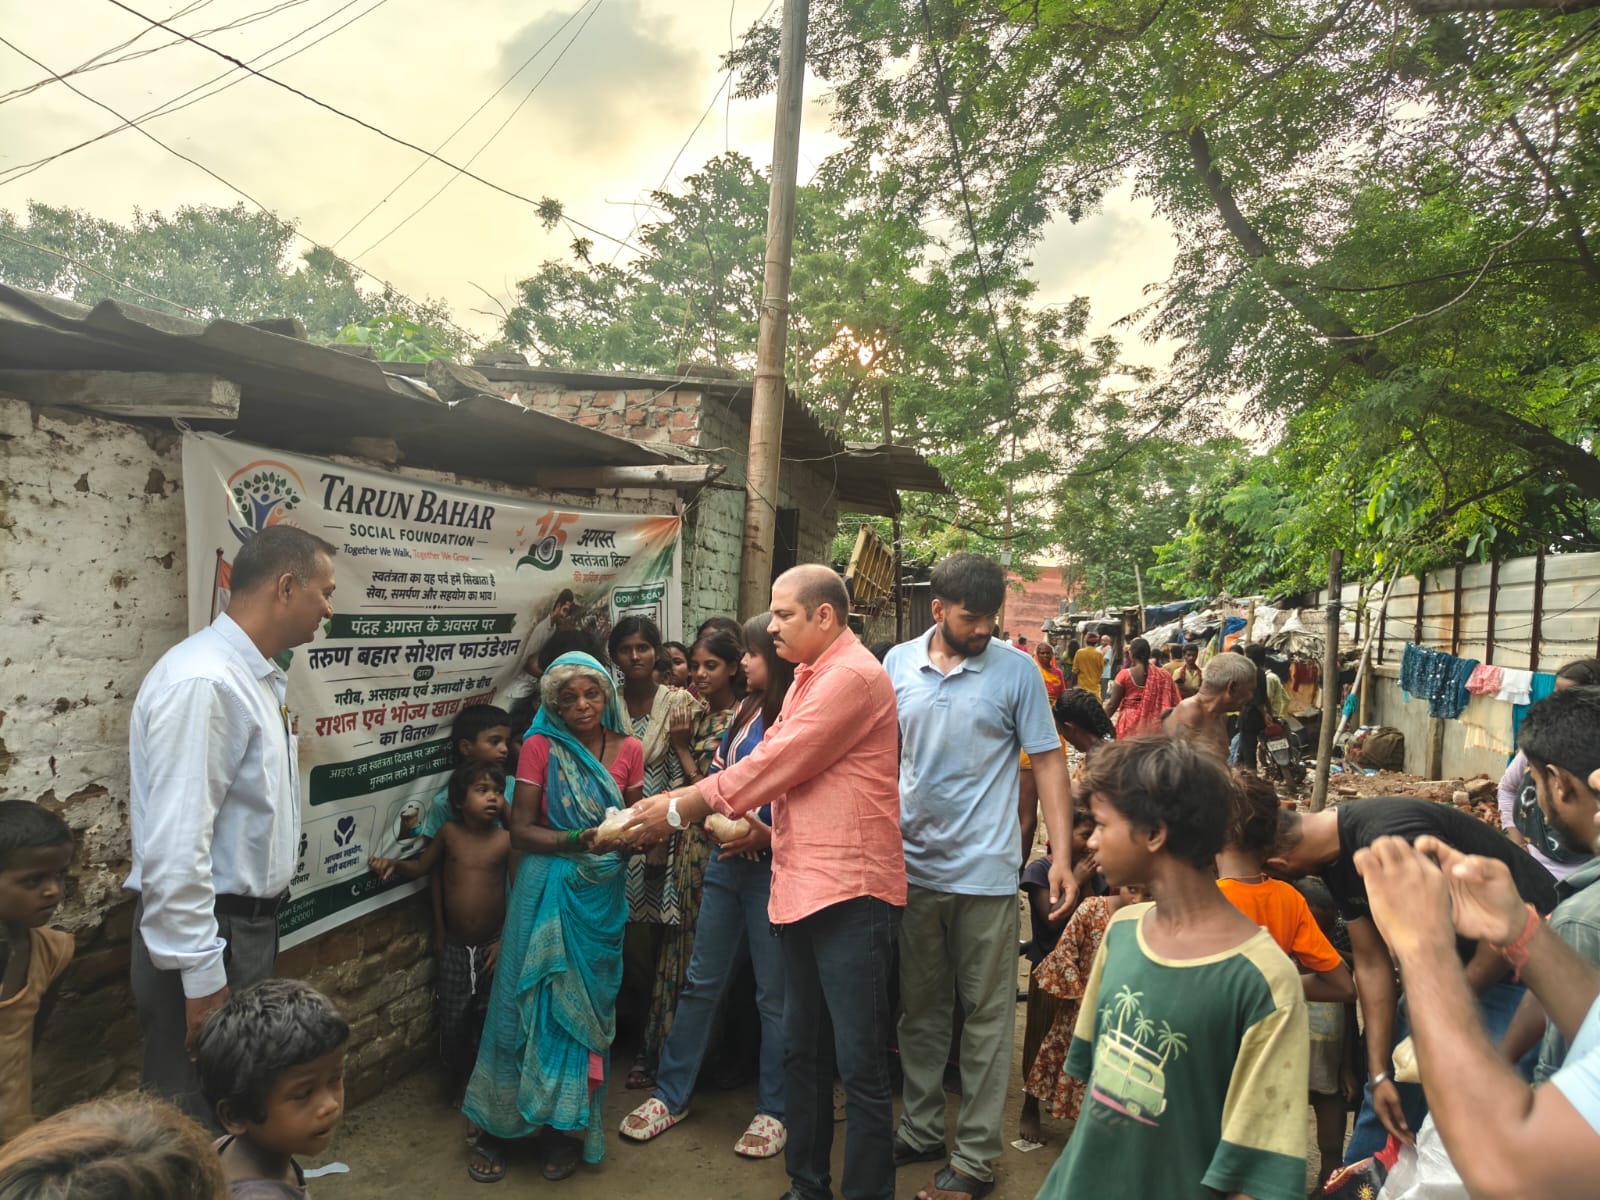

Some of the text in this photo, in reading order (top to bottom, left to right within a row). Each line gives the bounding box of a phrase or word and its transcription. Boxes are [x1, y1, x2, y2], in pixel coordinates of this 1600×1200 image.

[320, 474, 496, 530] TARUN BAHAR
[350, 523, 475, 547] SOCIAL FOUNDATION
[577, 528, 616, 549] अगस्त
[344, 544, 377, 556] Together
[379, 545, 392, 556] We
[392, 546, 412, 559] Walk,
[413, 549, 440, 561] Together
[570, 551, 609, 568] स्वतंत्रता
[372, 569, 408, 584] स्वतंत्रता
[410, 573, 421, 584] का
[424, 574, 436, 585] यह
[437, 571, 449, 585] पर्व
[463, 572, 489, 586] सिखाता
[489, 573, 496, 587] है
[366, 585, 388, 601] सेवा,
[391, 586, 421, 600] समर्पण
[421, 587, 438, 600] और
[440, 588, 466, 601] सहयोग
[467, 590, 478, 601] का
[351, 616, 497, 636] पंद्रह अगस्त के अवसर पर
[308, 636, 521, 670] तरुण बहार सोशल फाउंडेशन
[334, 688, 365, 706] गरीब,
[368, 686, 410, 702] असहाय
[413, 681, 428, 698] एवं
[465, 678, 475, 691] के
[476, 675, 493, 689] बीच
[315, 711, 359, 738] राशन
[362, 703, 387, 730] एवं
[390, 700, 430, 724] भोज्य
[431, 698, 462, 718] खाद्य
[379, 724, 439, 747] का वितरण
[357, 764, 368, 776] इस
